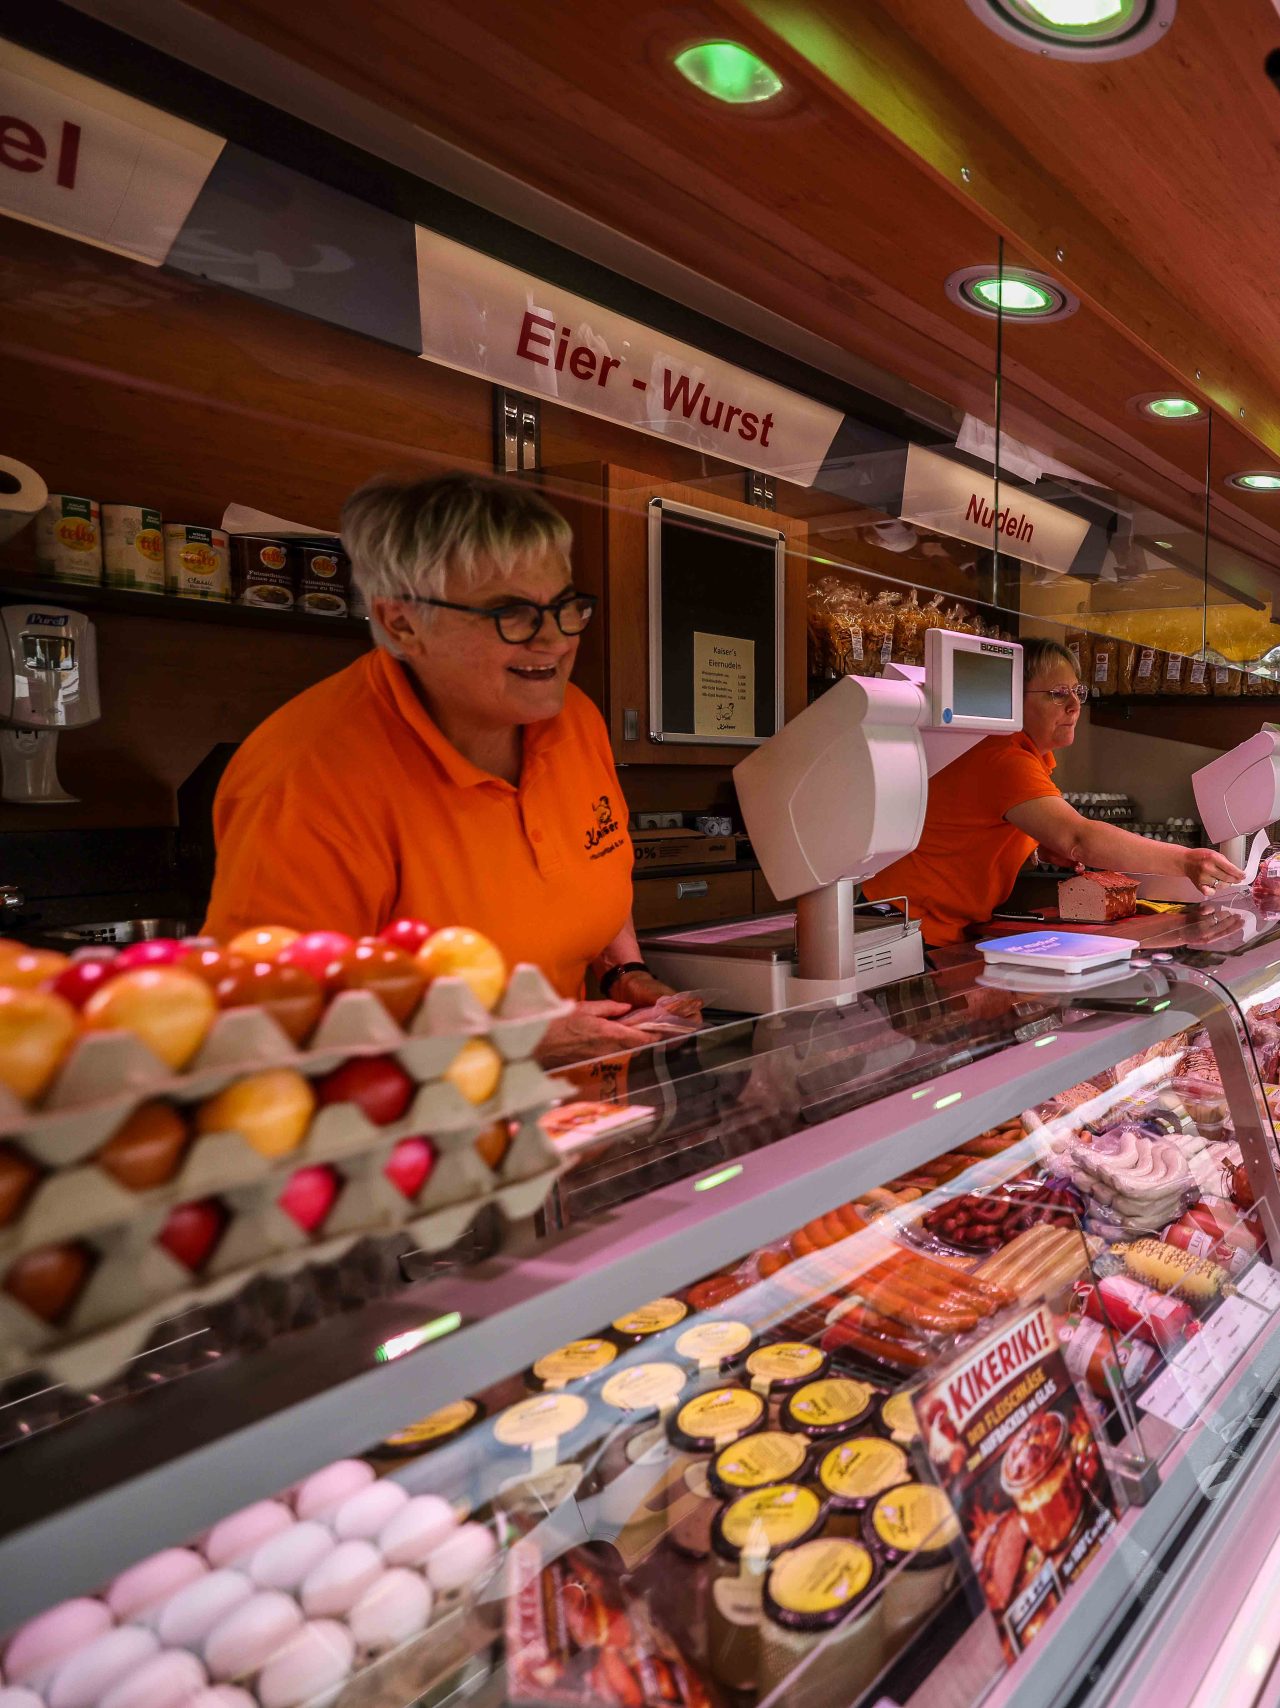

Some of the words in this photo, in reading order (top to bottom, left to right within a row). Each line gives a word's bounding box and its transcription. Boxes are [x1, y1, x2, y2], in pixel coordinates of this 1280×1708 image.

[516, 311, 621, 388] Eier
[663, 368, 774, 448] Wurst
[965, 493, 1034, 543] Nudeln
[713, 646, 737, 657] Kaiser's
[980, 643, 1014, 656] BIZERBA
[948, 1311, 1050, 1420] KIKERIKI!
